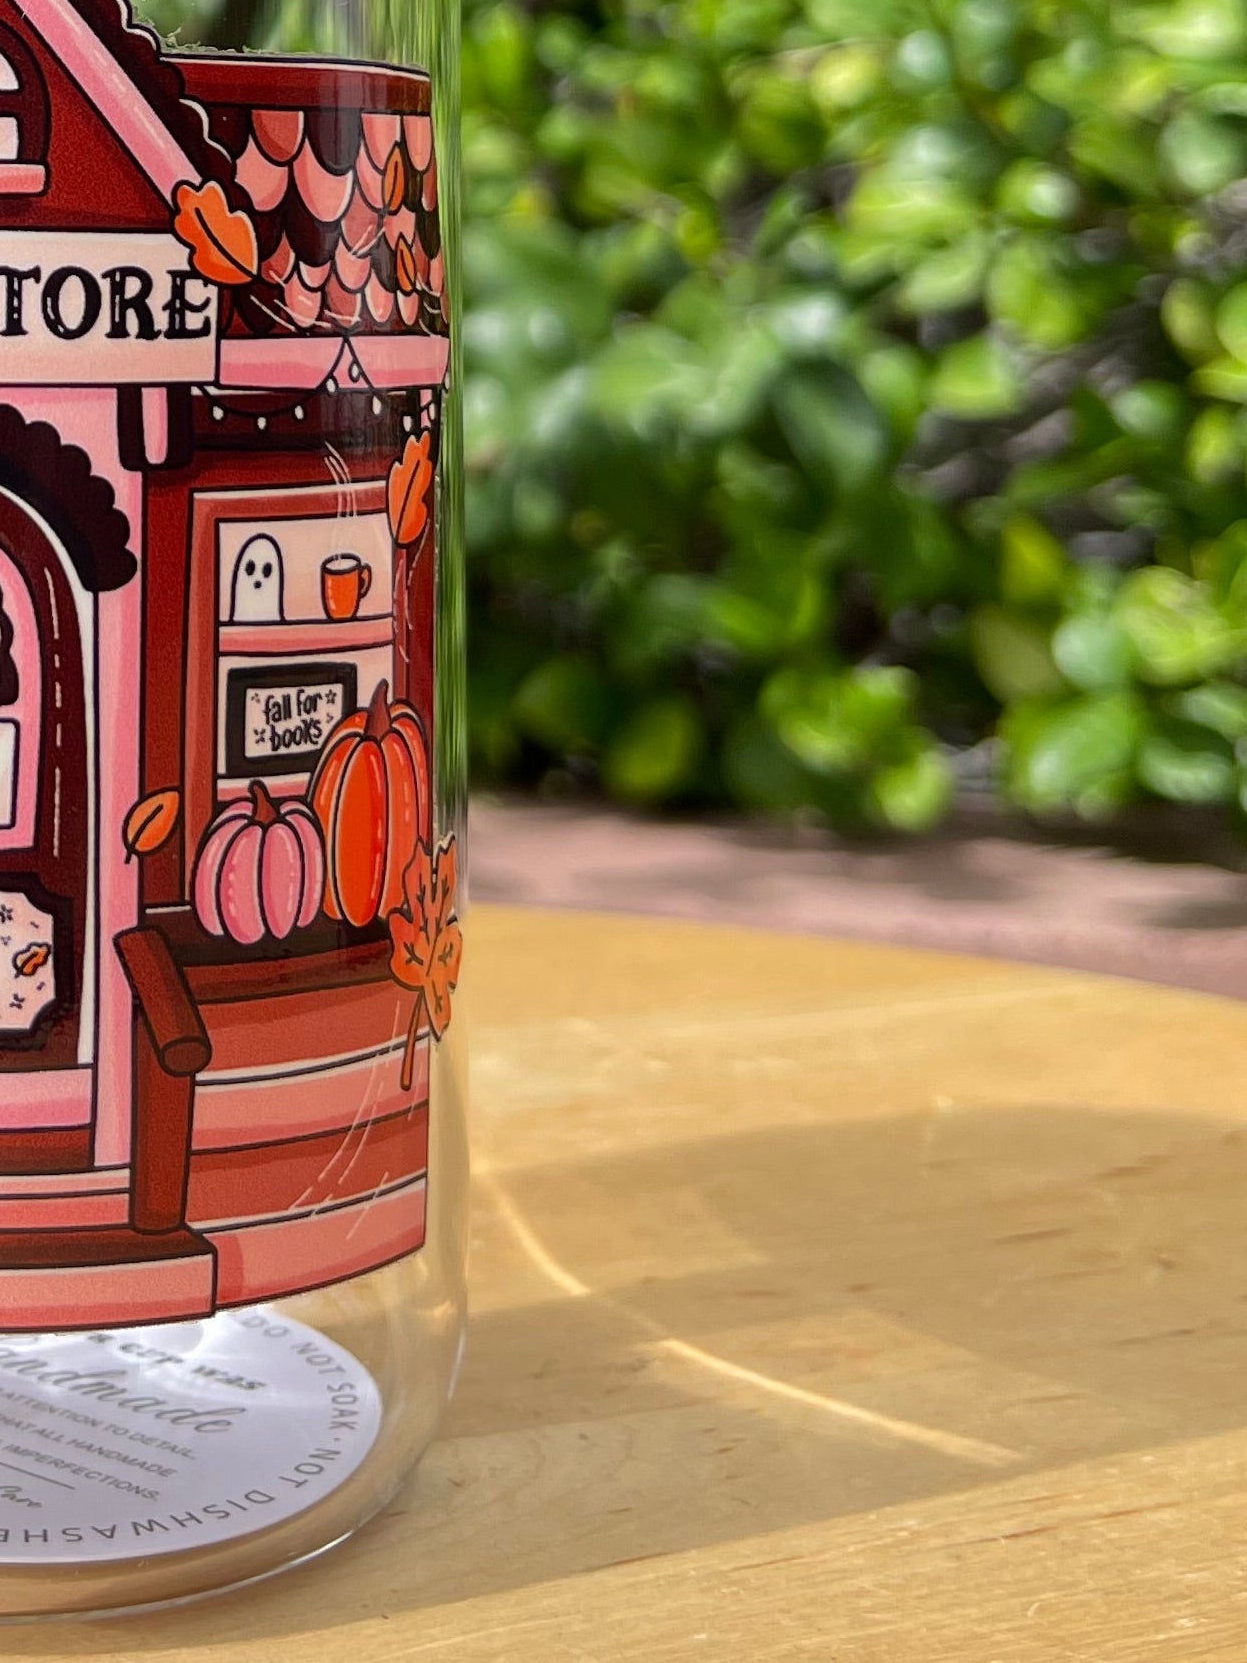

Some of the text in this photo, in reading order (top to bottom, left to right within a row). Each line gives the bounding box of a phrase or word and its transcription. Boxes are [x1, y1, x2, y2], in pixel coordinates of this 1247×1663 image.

[263, 694, 293, 726] fall
[242, 1315, 290, 1339] DO
[293, 1342, 346, 1375] NOT
[1, 1391, 99, 1429] ATTENTION
[103, 1423, 130, 1437] TO
[326, 1381, 359, 1431] SOAK
[1, 1443, 163, 1502] IMPERFECTIONS.
[65, 1439, 178, 1479] HANDMADE
[278, 1447, 342, 1488] NOT
